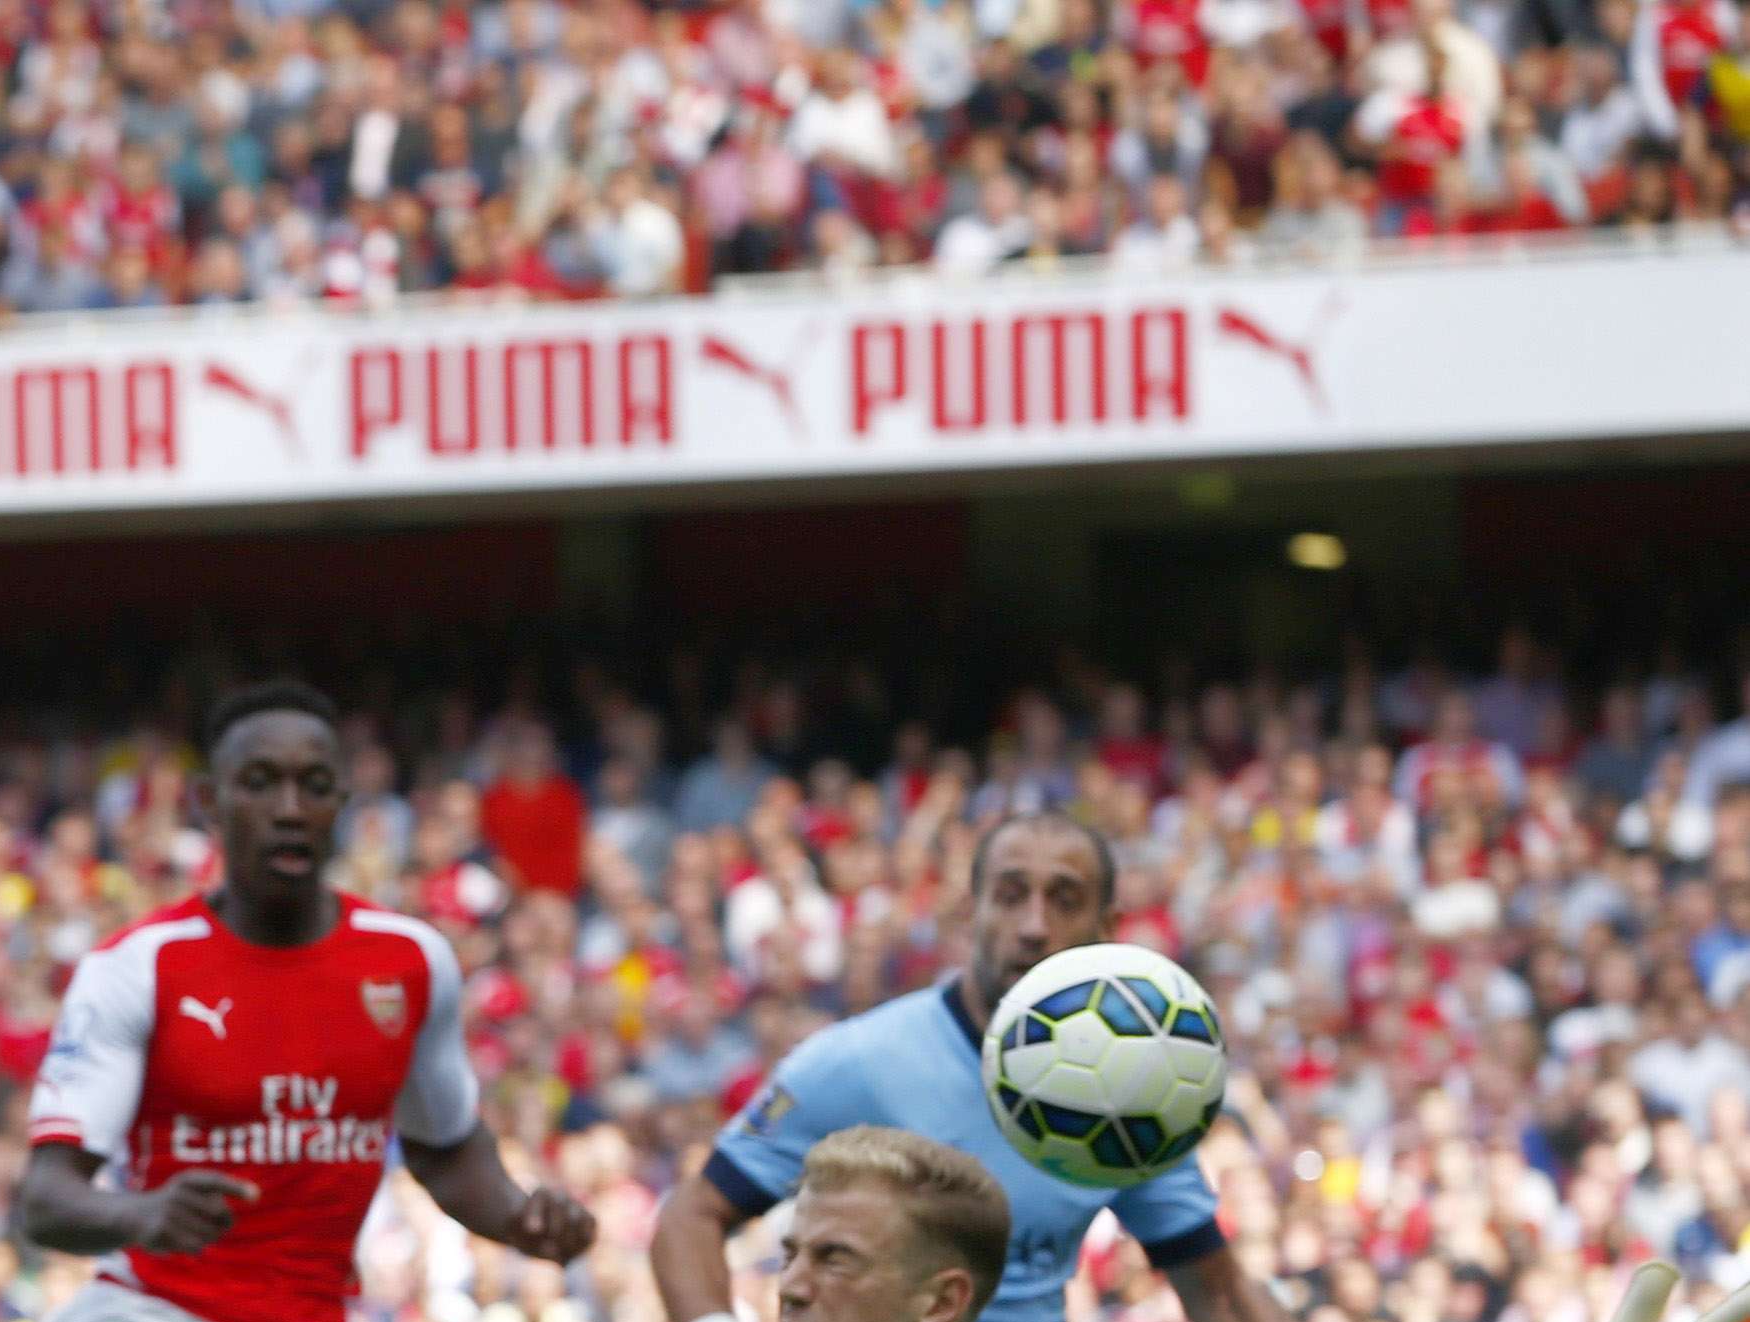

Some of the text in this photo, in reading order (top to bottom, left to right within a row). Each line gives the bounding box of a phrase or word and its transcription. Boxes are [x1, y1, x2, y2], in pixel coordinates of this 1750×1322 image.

[348, 331, 674, 458] PUMA
[850, 304, 1188, 436] PUMA
[260, 1074, 338, 1118] Fly
